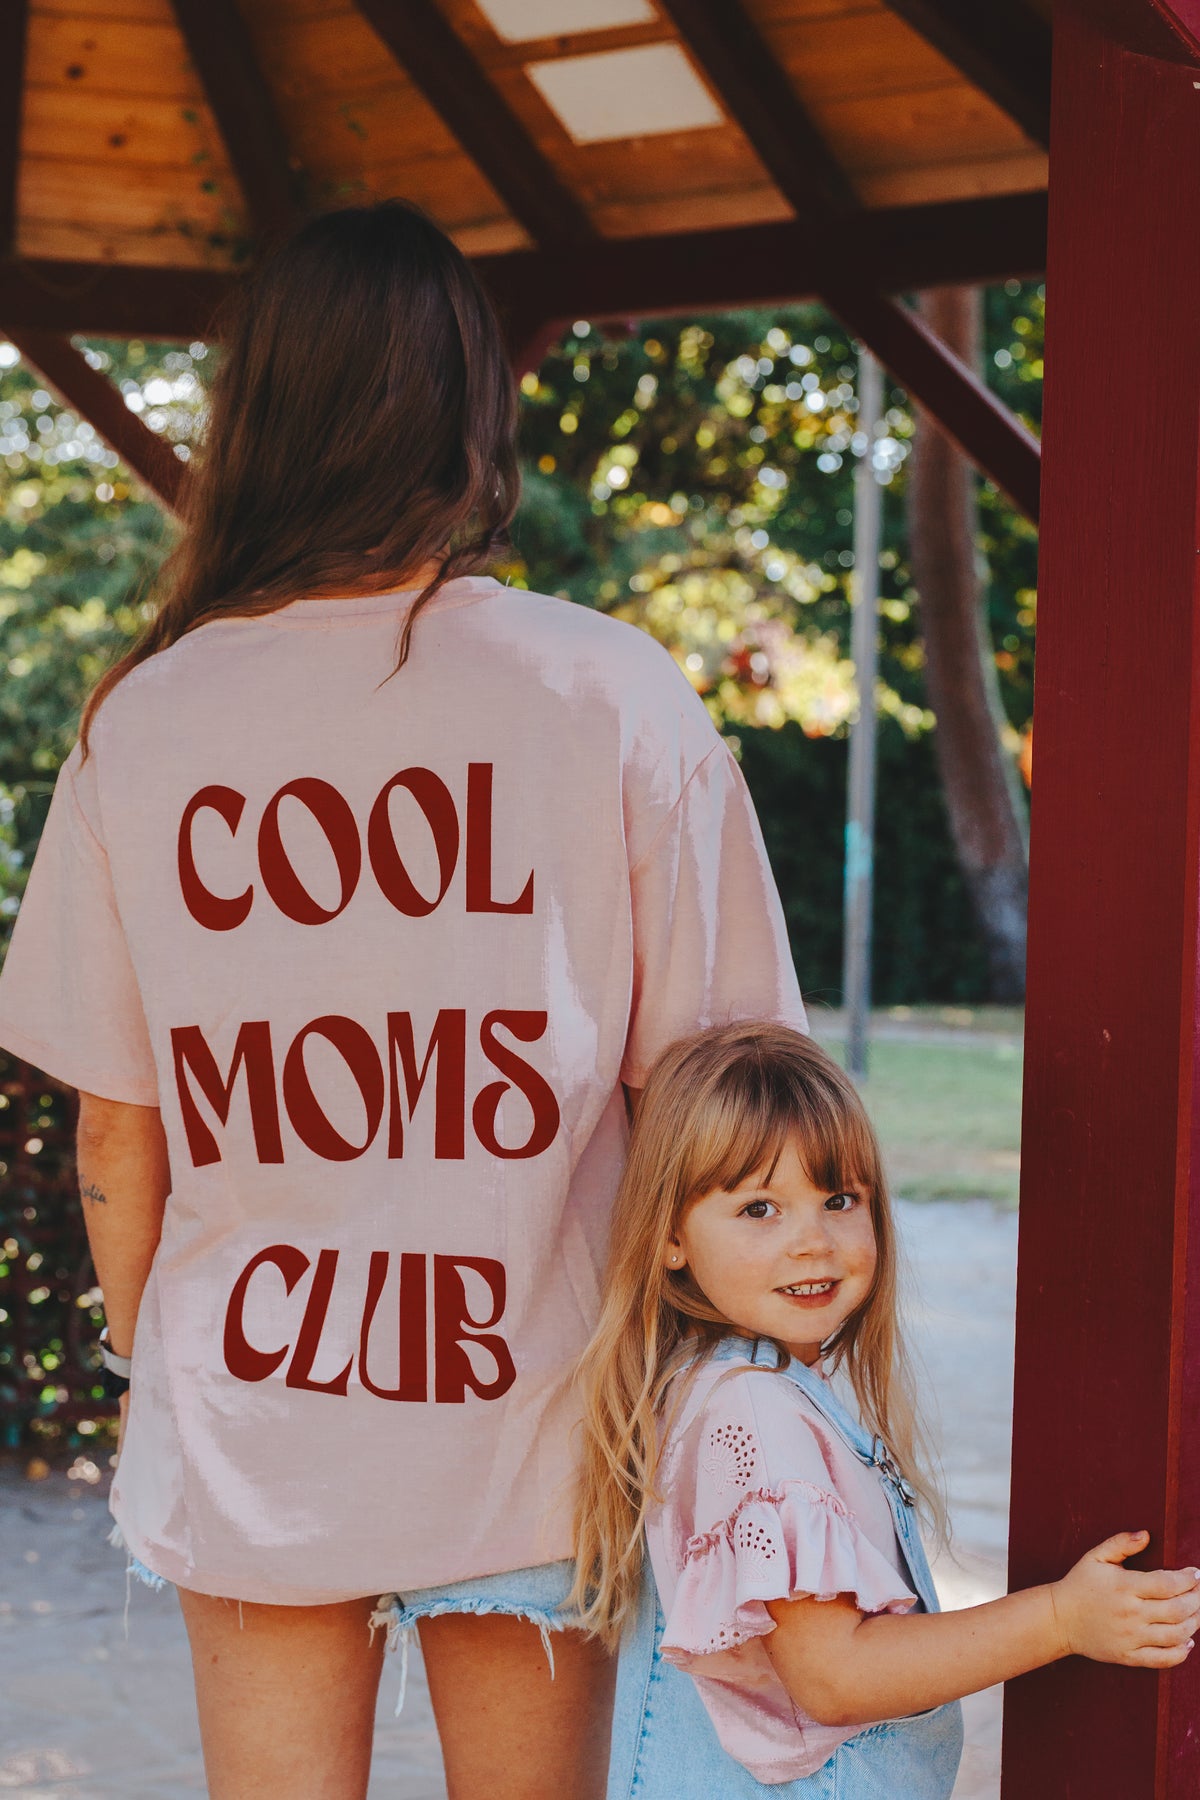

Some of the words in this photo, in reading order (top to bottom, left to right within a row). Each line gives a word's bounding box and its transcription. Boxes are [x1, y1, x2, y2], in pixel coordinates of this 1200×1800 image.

[177, 763, 534, 931] COOL
[170, 1009, 560, 1168] MOMS
[223, 1244, 517, 1403] CLUB
